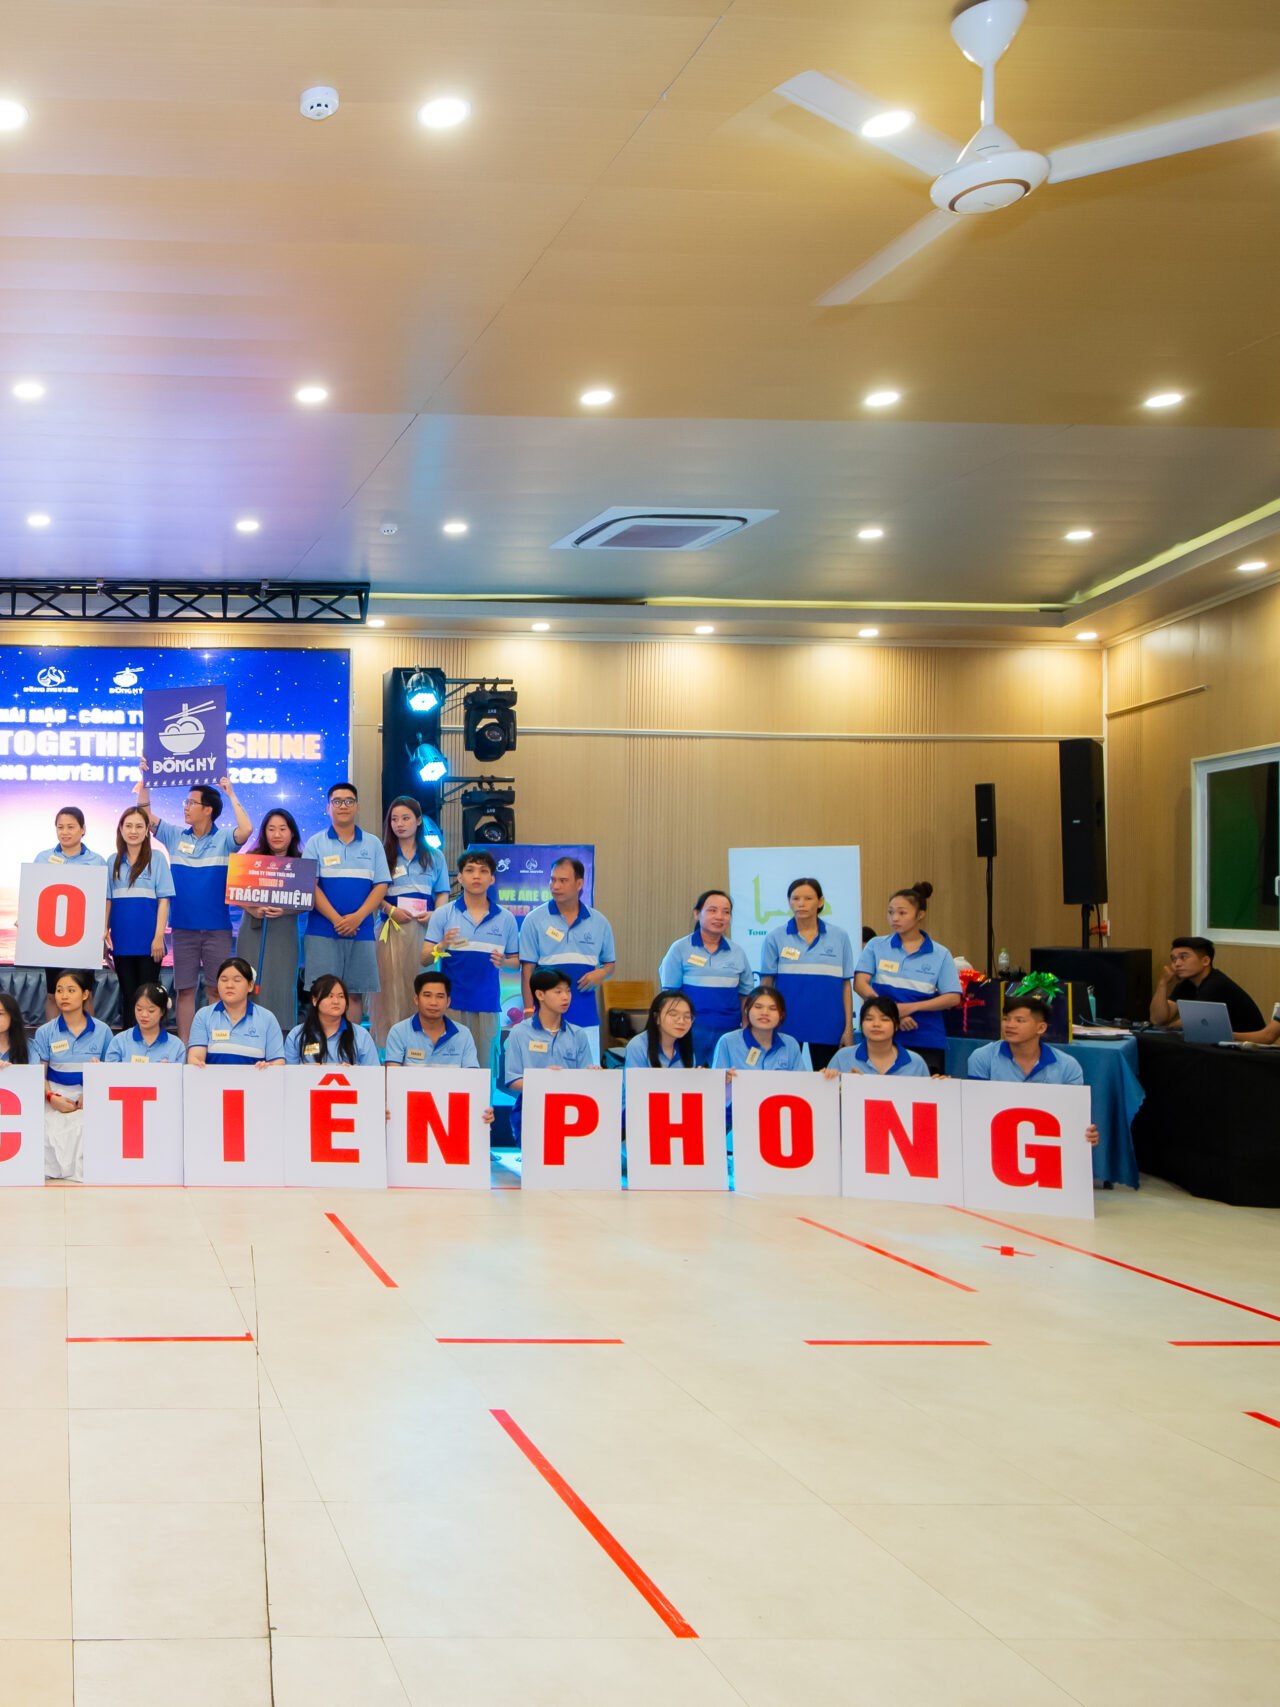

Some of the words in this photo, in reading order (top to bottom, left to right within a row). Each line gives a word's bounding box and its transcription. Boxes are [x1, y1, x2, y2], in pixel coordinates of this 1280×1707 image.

[226, 733, 322, 760] SHINE
[229, 886, 269, 902] TRÁCH
[271, 889, 313, 908] NHIỆM
[108, 1073, 470, 1165] TIÊN
[543, 1092, 1063, 1190] PHONG
